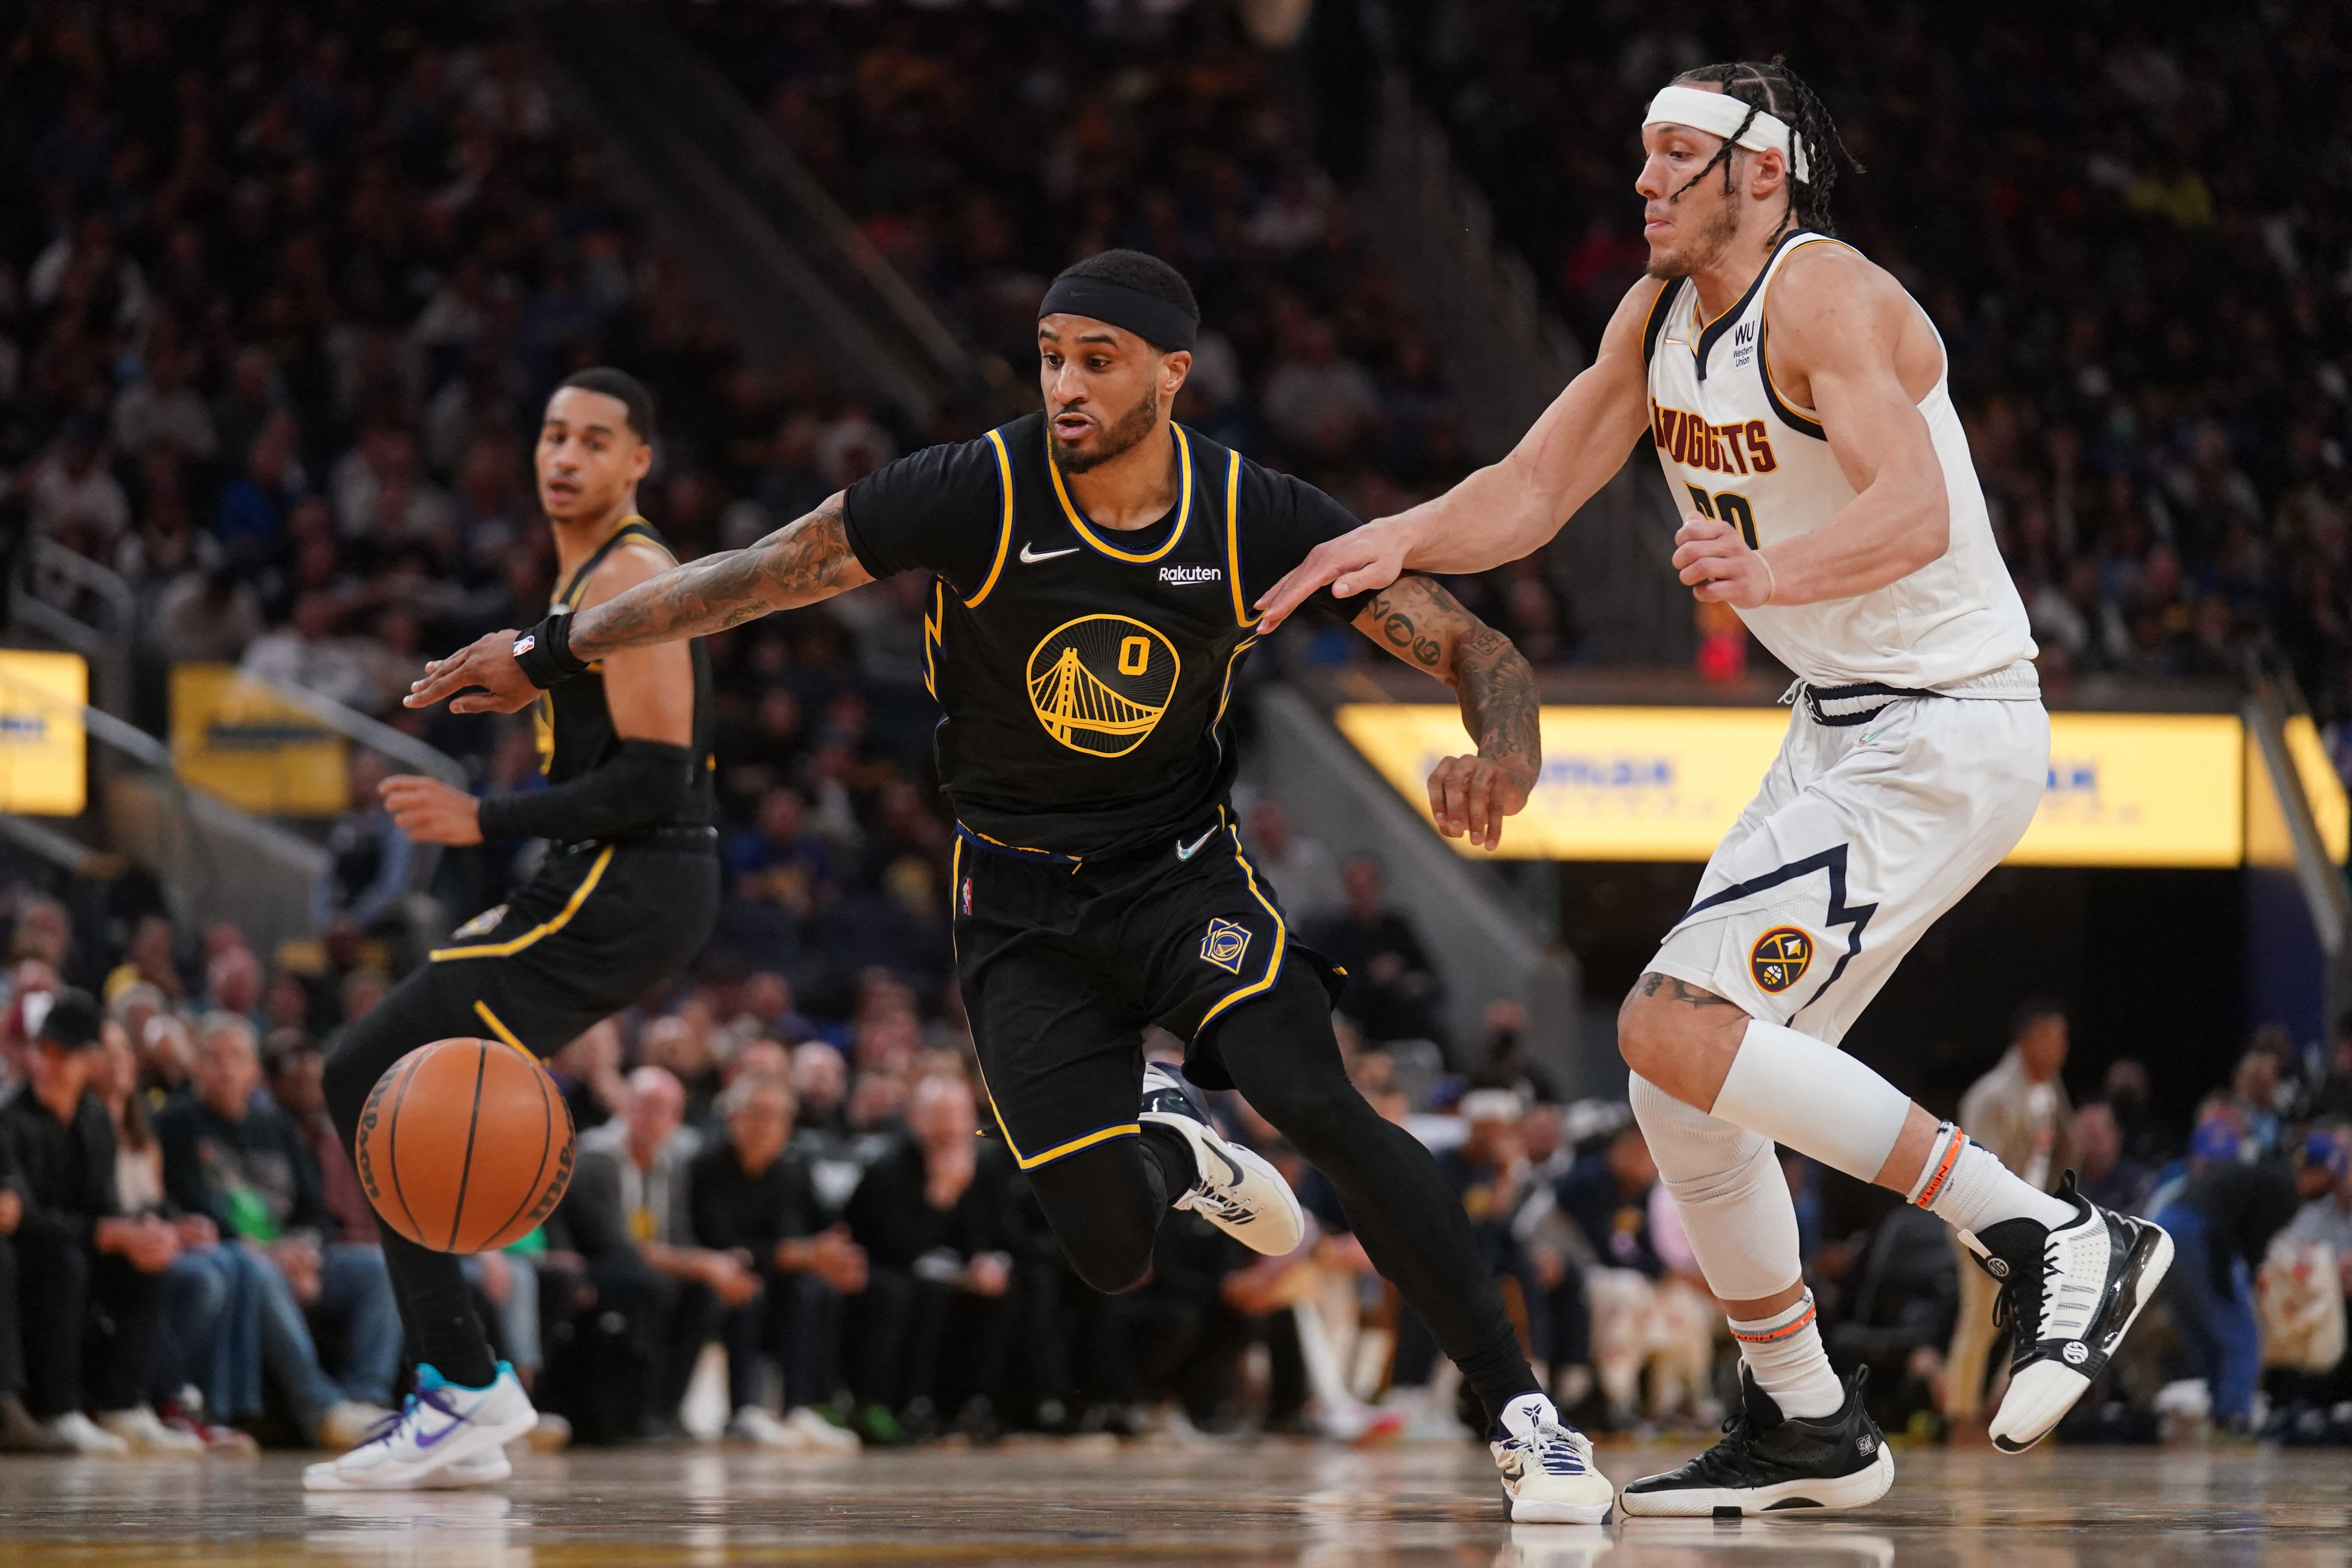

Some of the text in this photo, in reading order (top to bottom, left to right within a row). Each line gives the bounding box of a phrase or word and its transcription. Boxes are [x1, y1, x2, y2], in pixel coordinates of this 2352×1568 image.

[1735, 320, 1755, 346] WU
[1733, 346, 1753, 359] Western
[1735, 356, 1750, 367] Union
[1158, 566, 1221, 581] Rakuten
[1118, 636, 1151, 676] 0
